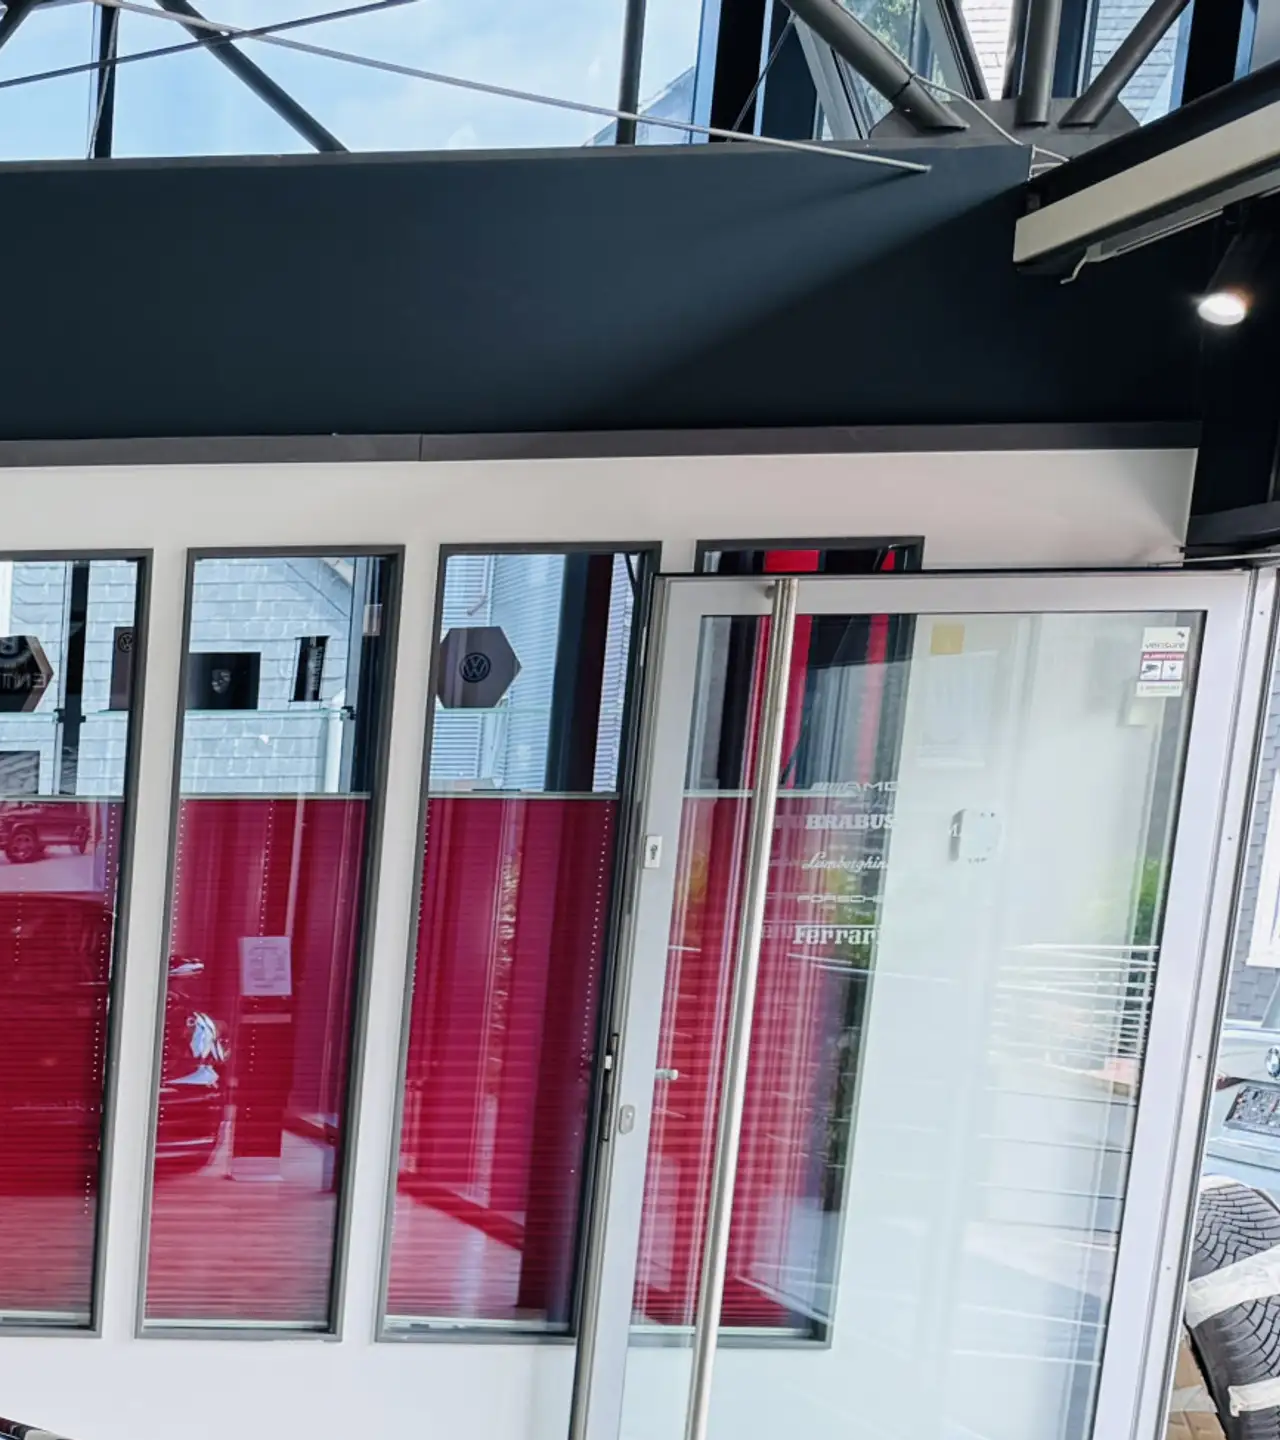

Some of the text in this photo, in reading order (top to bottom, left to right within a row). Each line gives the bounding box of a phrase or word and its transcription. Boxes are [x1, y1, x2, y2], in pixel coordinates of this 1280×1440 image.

[805, 814, 895, 830] BRABUS
[801, 851, 887, 875] Lamborghin
[792, 924, 878, 945] Ferrar
